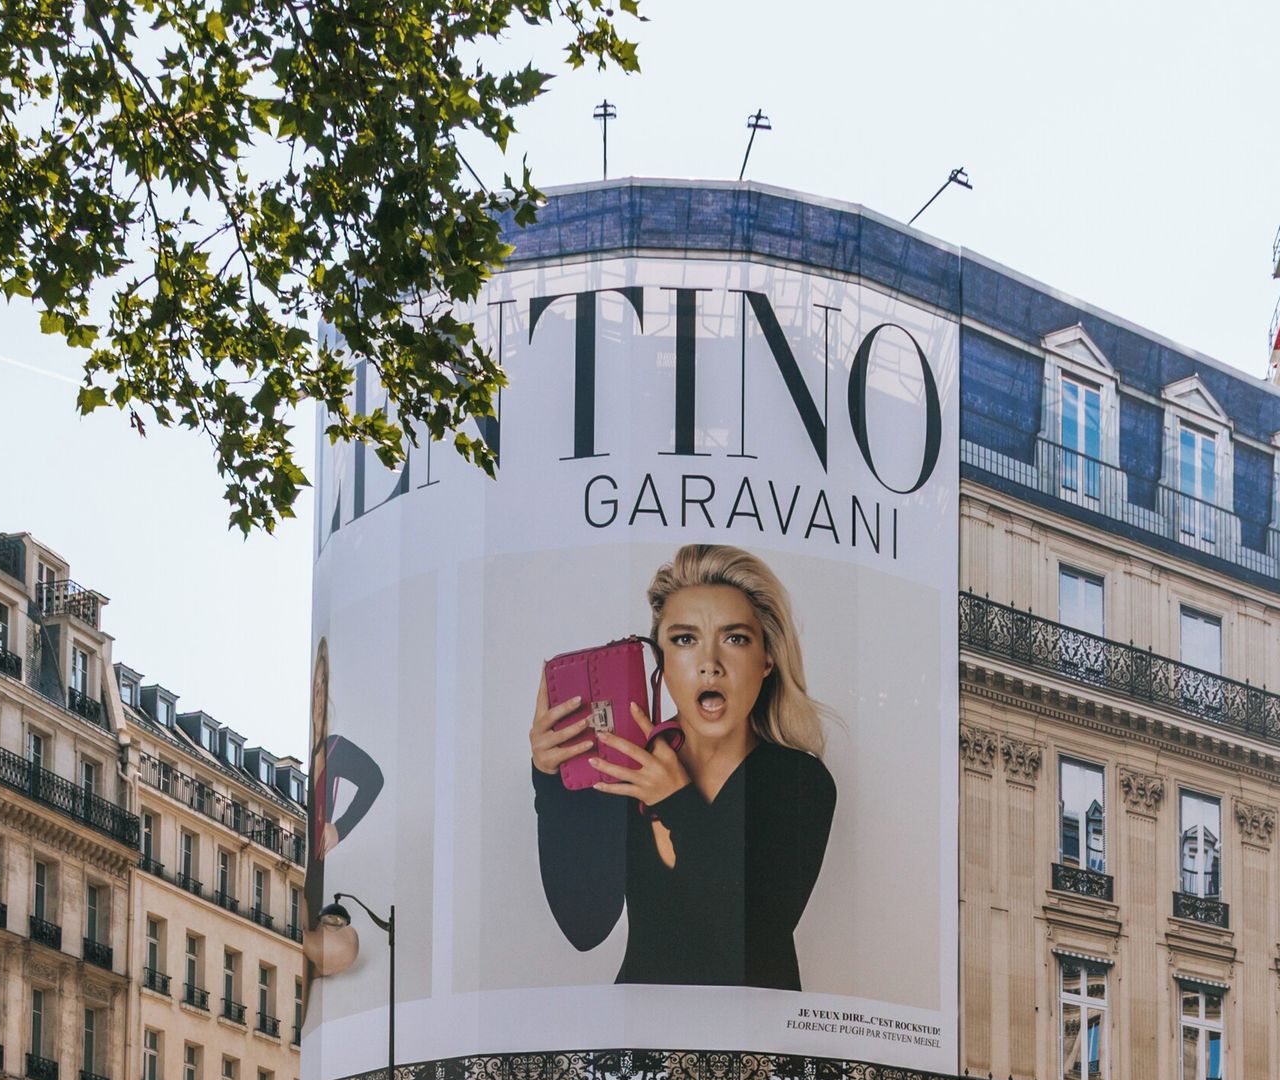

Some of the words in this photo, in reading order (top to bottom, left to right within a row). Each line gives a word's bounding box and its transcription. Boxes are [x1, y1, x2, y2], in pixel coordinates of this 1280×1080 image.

[317, 286, 943, 560] ENTINO
[584, 473, 897, 559] GARAVANI
[786, 1020, 837, 1033] FLORENCE
[839, 1025, 865, 1036] PUGH
[866, 1028, 881, 1039] PAR
[882, 1031, 912, 1044] STEVEN
[913, 1036, 941, 1049] MEISEL
[798, 1008, 810, 1018] JE
[812, 1009, 840, 1020] VEUX
[895, 1021, 941, 1036] ROCKSTUD!
